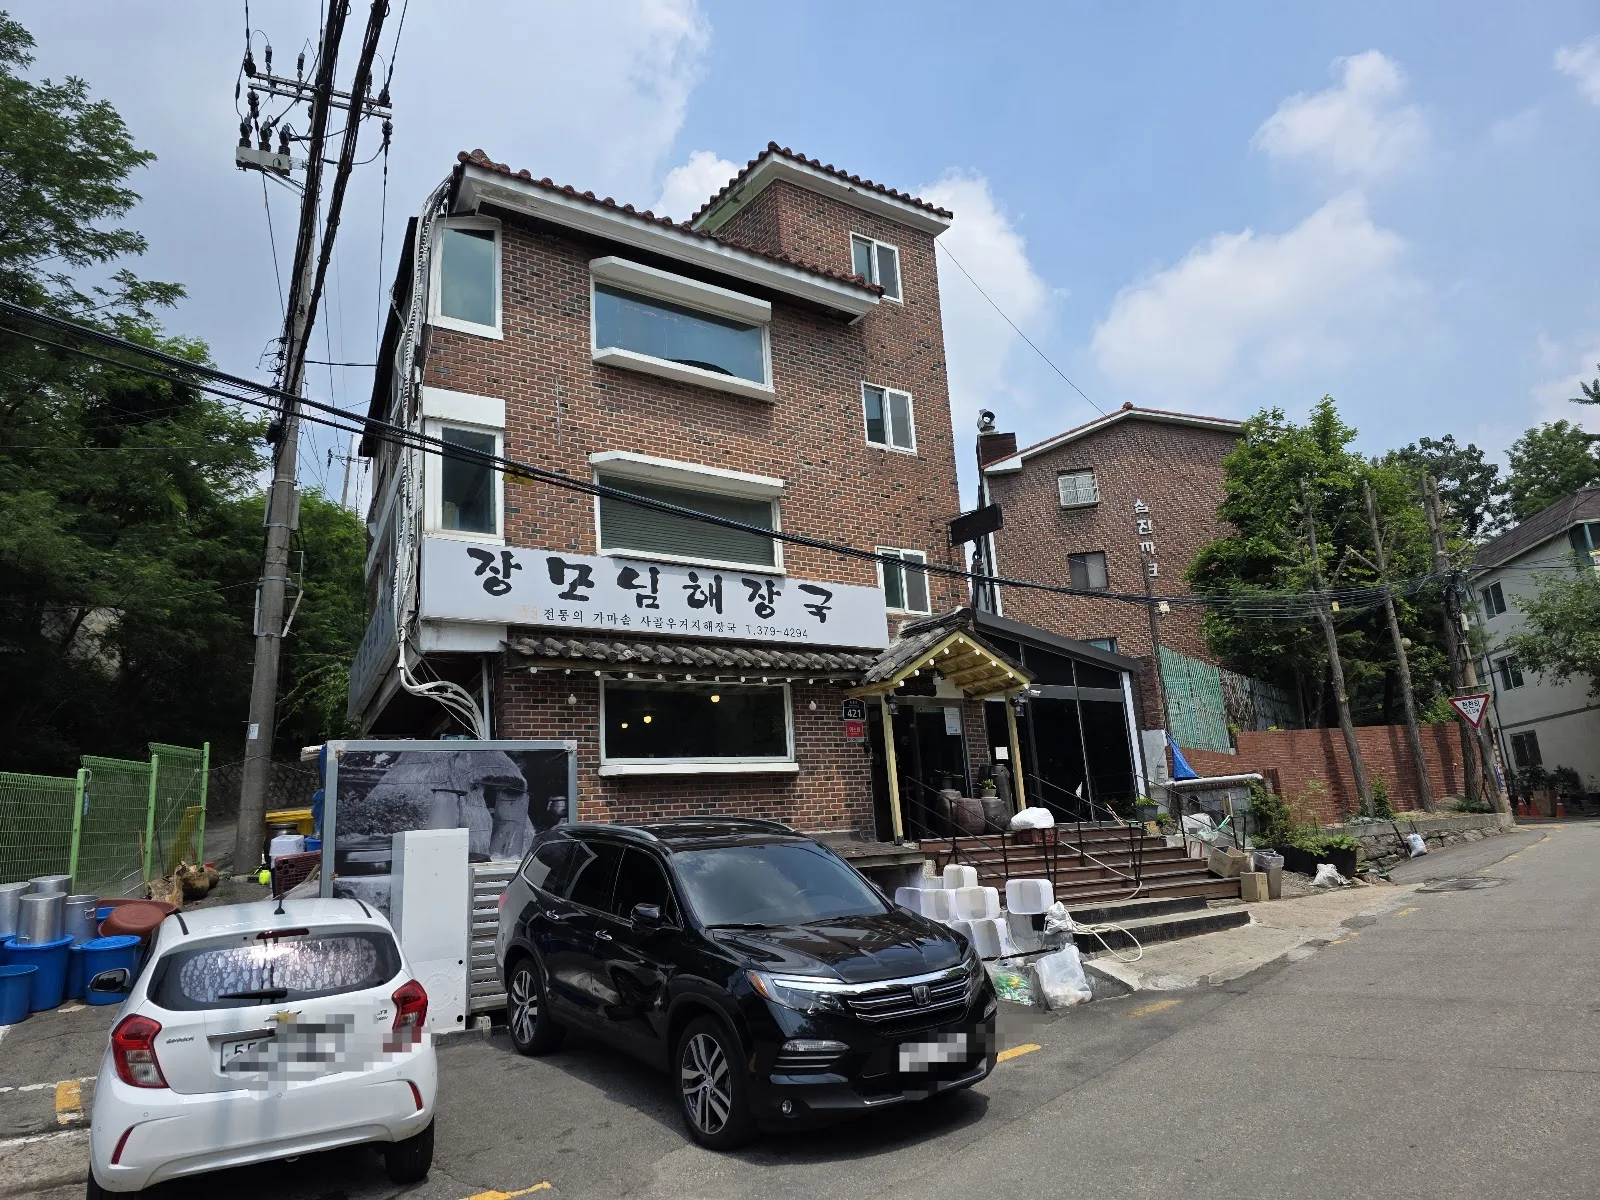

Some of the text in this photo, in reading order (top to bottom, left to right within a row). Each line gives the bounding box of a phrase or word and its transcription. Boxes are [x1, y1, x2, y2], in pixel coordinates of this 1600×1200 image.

[543, 607, 584, 624] 전통의
[640, 615, 737, 634] 사골우거지해장국
[1462, 699, 1480, 709] 천천히
[847, 709, 861, 718] 421
